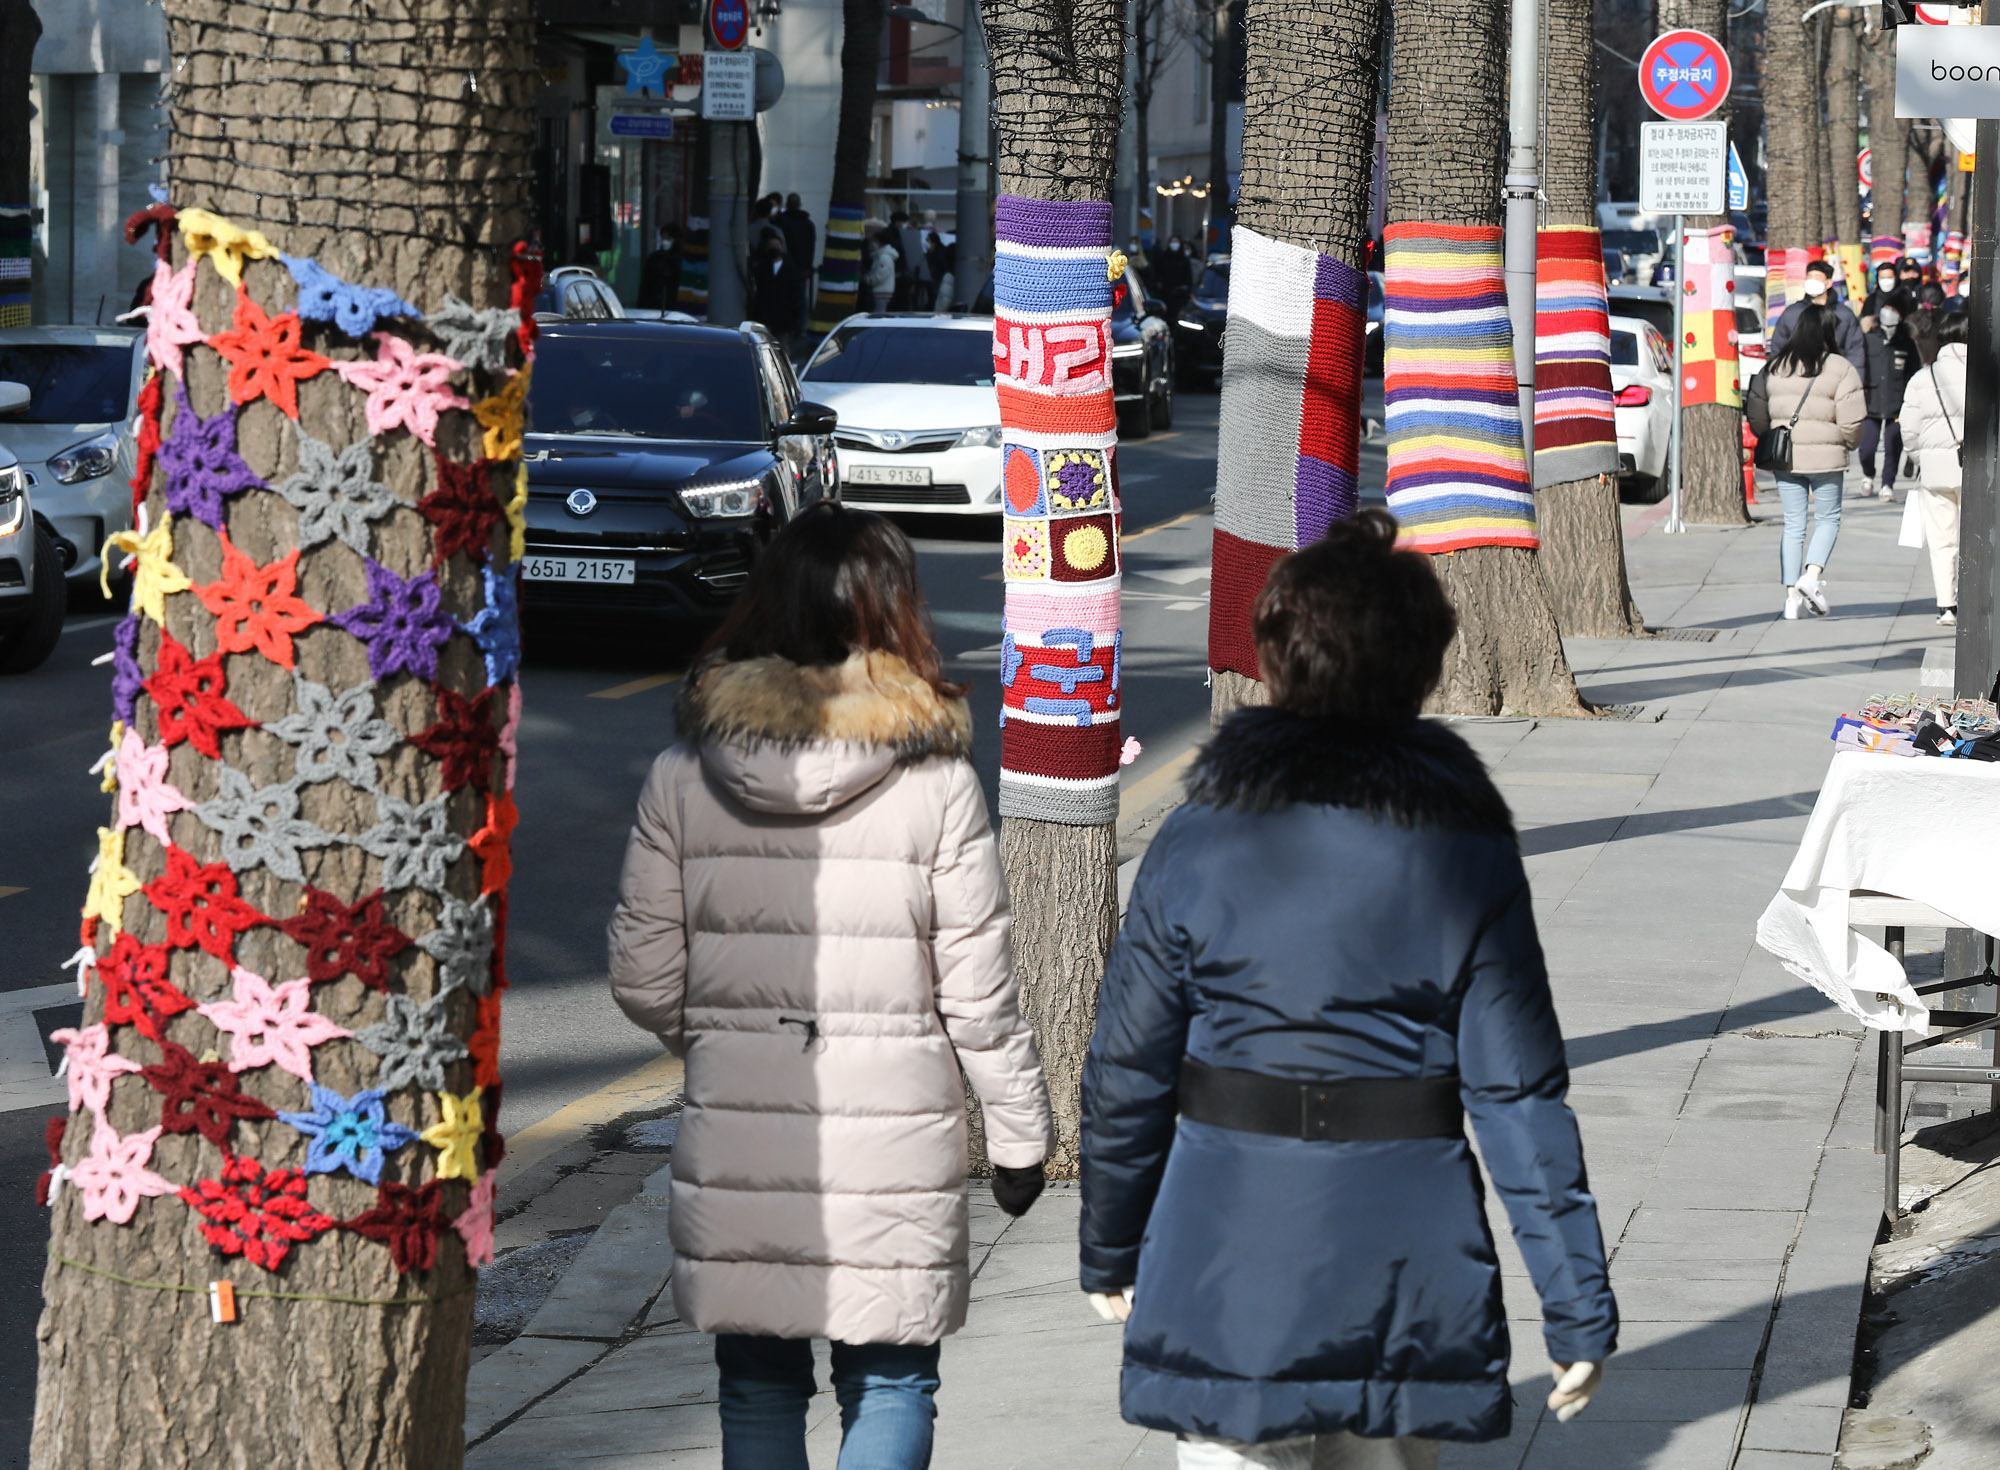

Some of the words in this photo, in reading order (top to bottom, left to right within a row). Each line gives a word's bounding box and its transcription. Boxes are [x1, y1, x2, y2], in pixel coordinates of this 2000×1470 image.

[1656, 67, 1712, 82] 주정차금지
[888, 470, 922, 483] 9136
[530, 559, 566, 578] 65고
[576, 561, 625, 580] 2157
